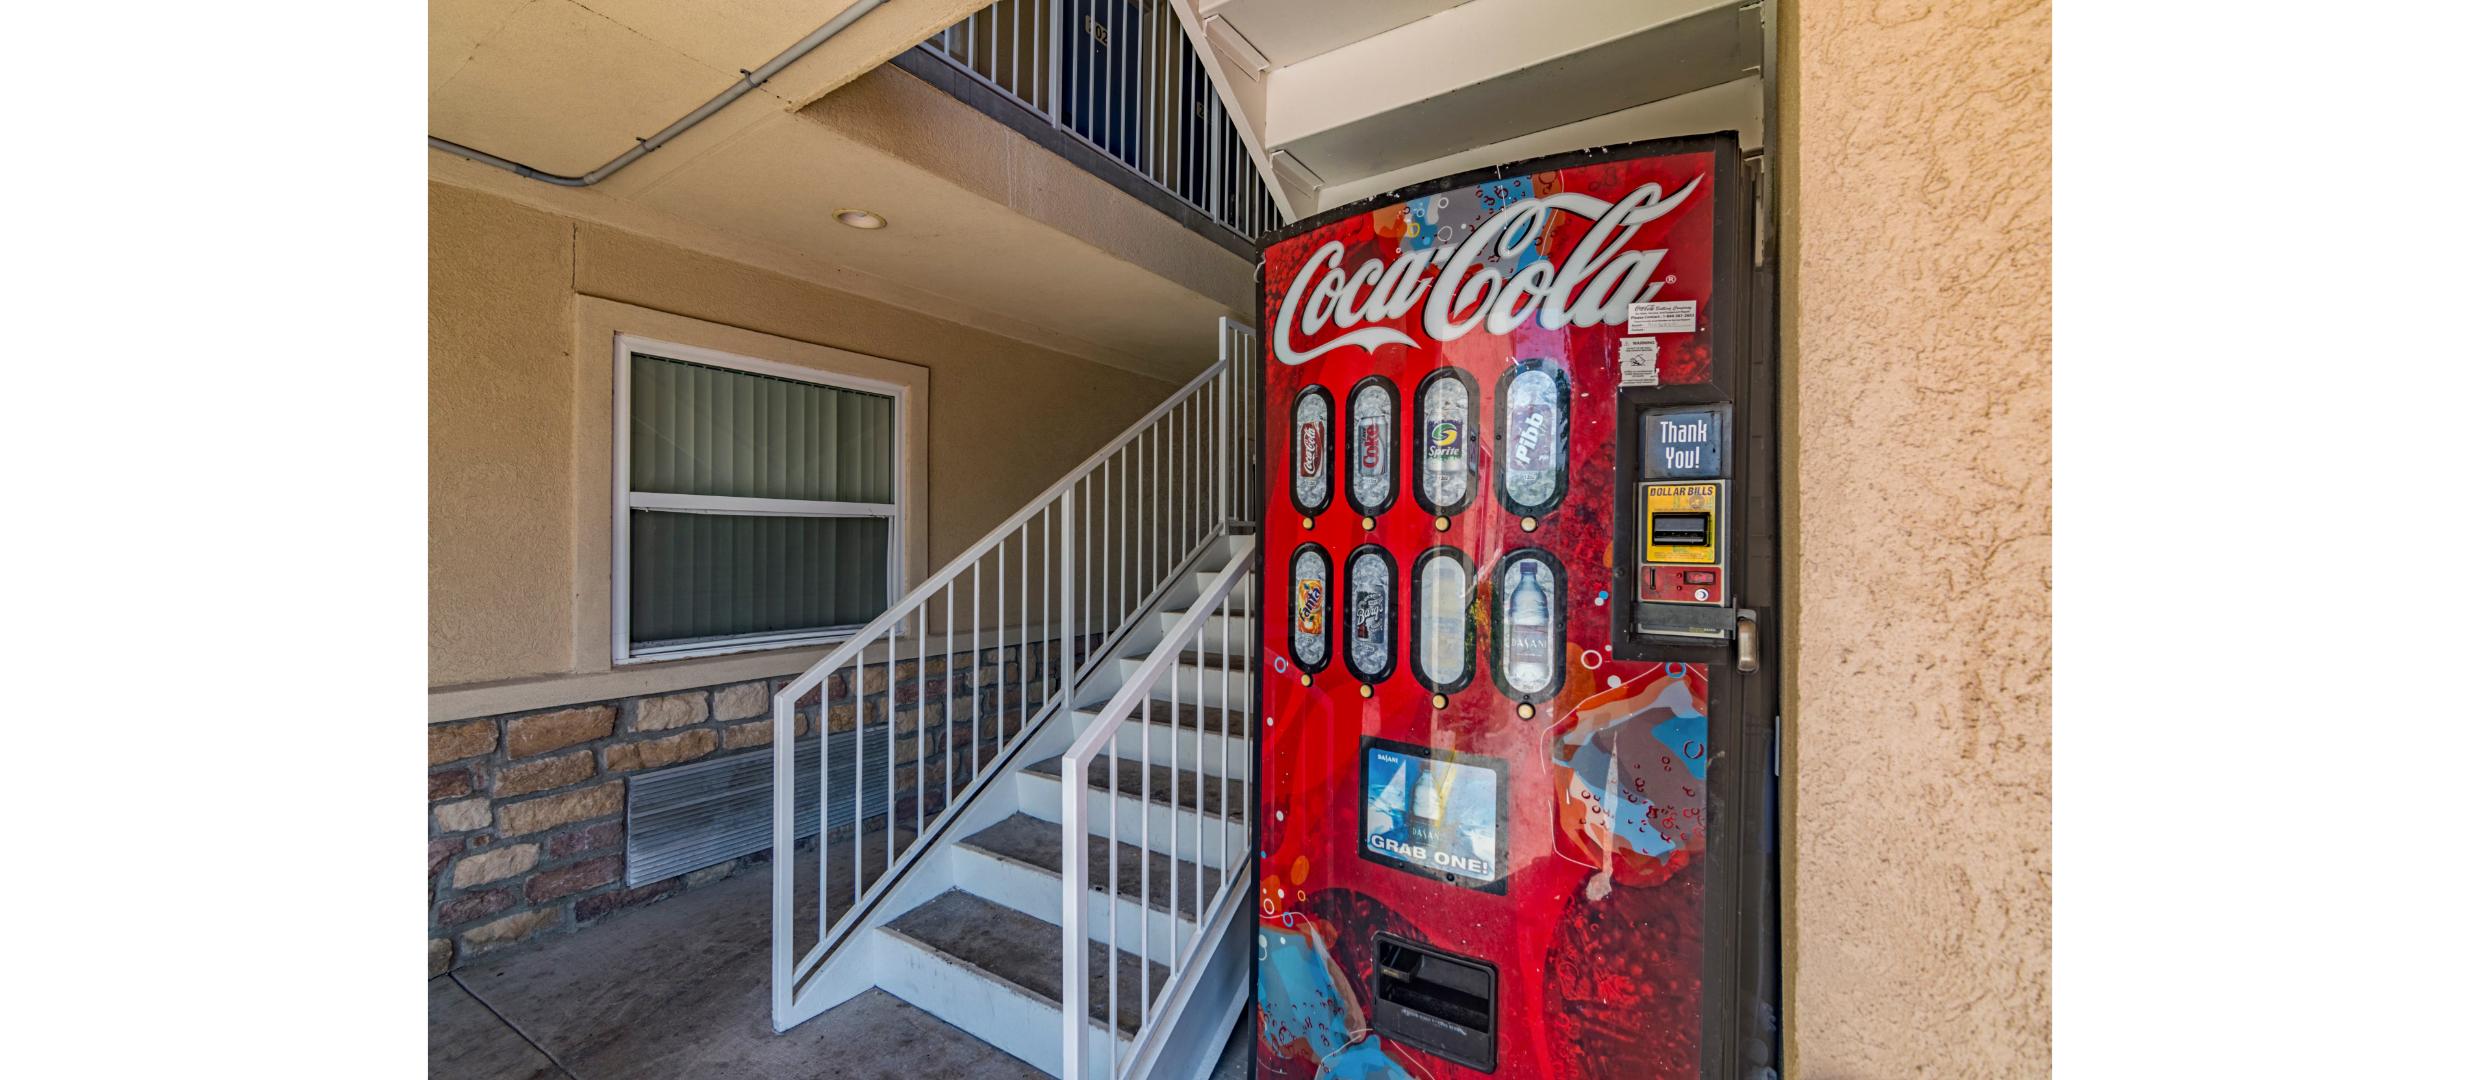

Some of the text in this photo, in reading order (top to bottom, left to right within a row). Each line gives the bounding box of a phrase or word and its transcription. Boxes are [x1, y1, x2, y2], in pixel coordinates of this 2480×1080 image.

[1272, 172, 1706, 367] Coca-Cola
[1363, 424, 1379, 469] Coke
[1515, 412, 1544, 465] Pibb
[1660, 419, 1708, 444] Thank
[1428, 445, 1460, 457] Sprite
[1665, 446, 1701, 469] You!
[1650, 486, 1714, 497] DOLLAR BILLS
[1370, 834, 1489, 875] GRAB ONE!
